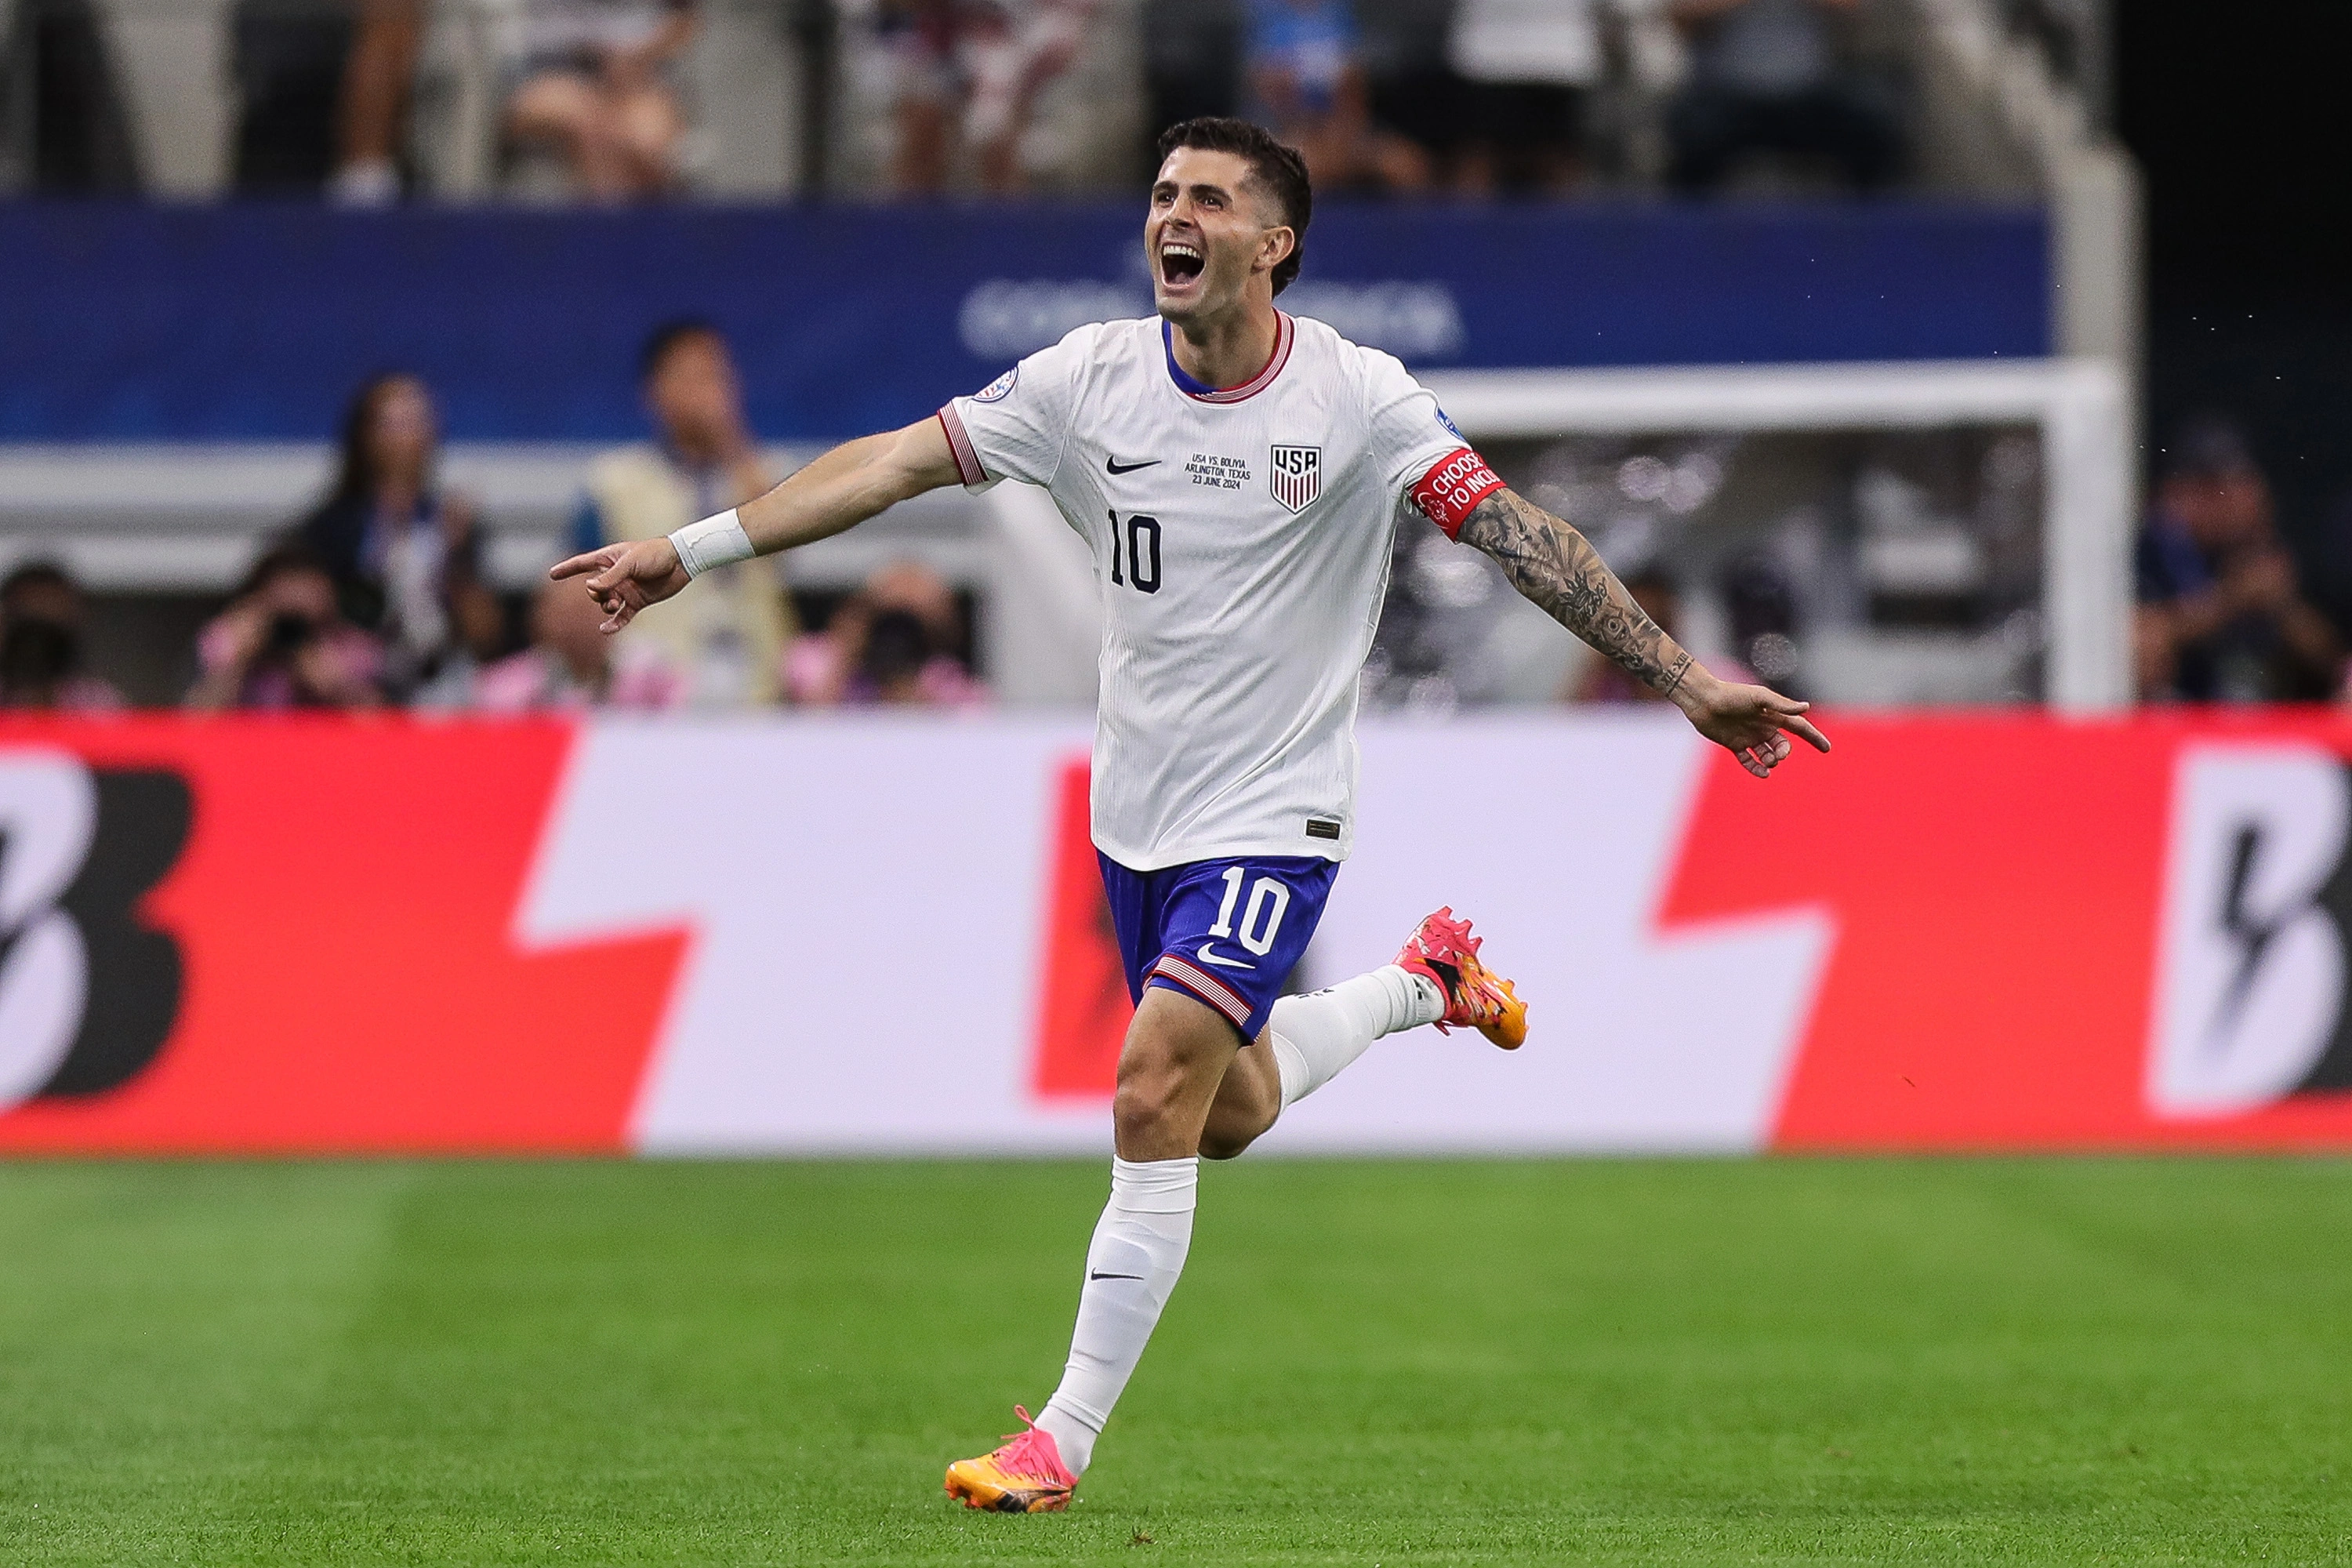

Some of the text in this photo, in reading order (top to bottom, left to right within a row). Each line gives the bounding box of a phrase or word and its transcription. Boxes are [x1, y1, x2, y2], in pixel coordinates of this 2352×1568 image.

[1192, 453, 1206, 464] USA
[1221, 458, 1246, 470] BOLIVIA
[1275, 449, 1317, 475] USA
[1432, 452, 1484, 495] CHOOSE
[1192, 474, 1240, 490] 23 JUNE 2024
[1229, 469, 1251, 481] TEXAS
[1447, 487, 1470, 510] TO
[1108, 509, 1161, 594] 10
[1208, 866, 1290, 956] 10
